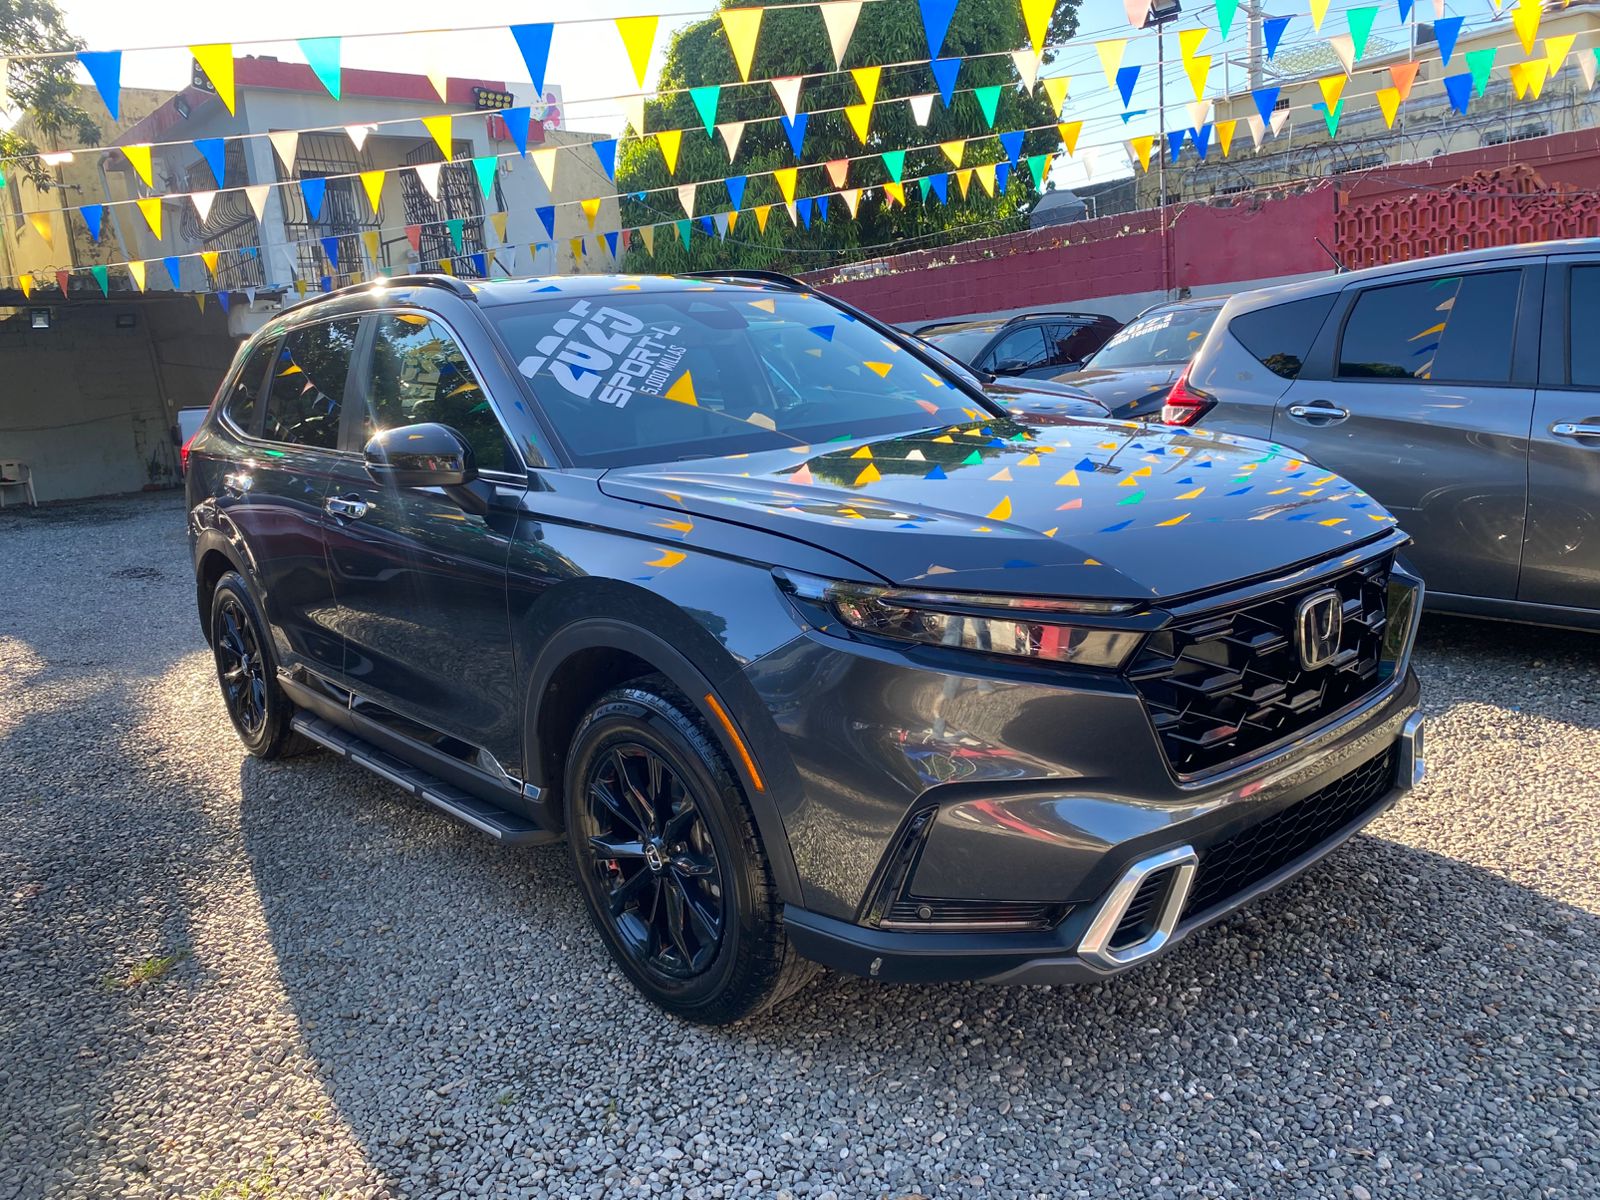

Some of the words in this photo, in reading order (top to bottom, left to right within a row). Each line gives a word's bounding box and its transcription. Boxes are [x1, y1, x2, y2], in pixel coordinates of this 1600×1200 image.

[518, 299, 644, 399] 2025
[598, 325, 681, 408] SPORT-L
[665, 344, 687, 372] MILLAS
